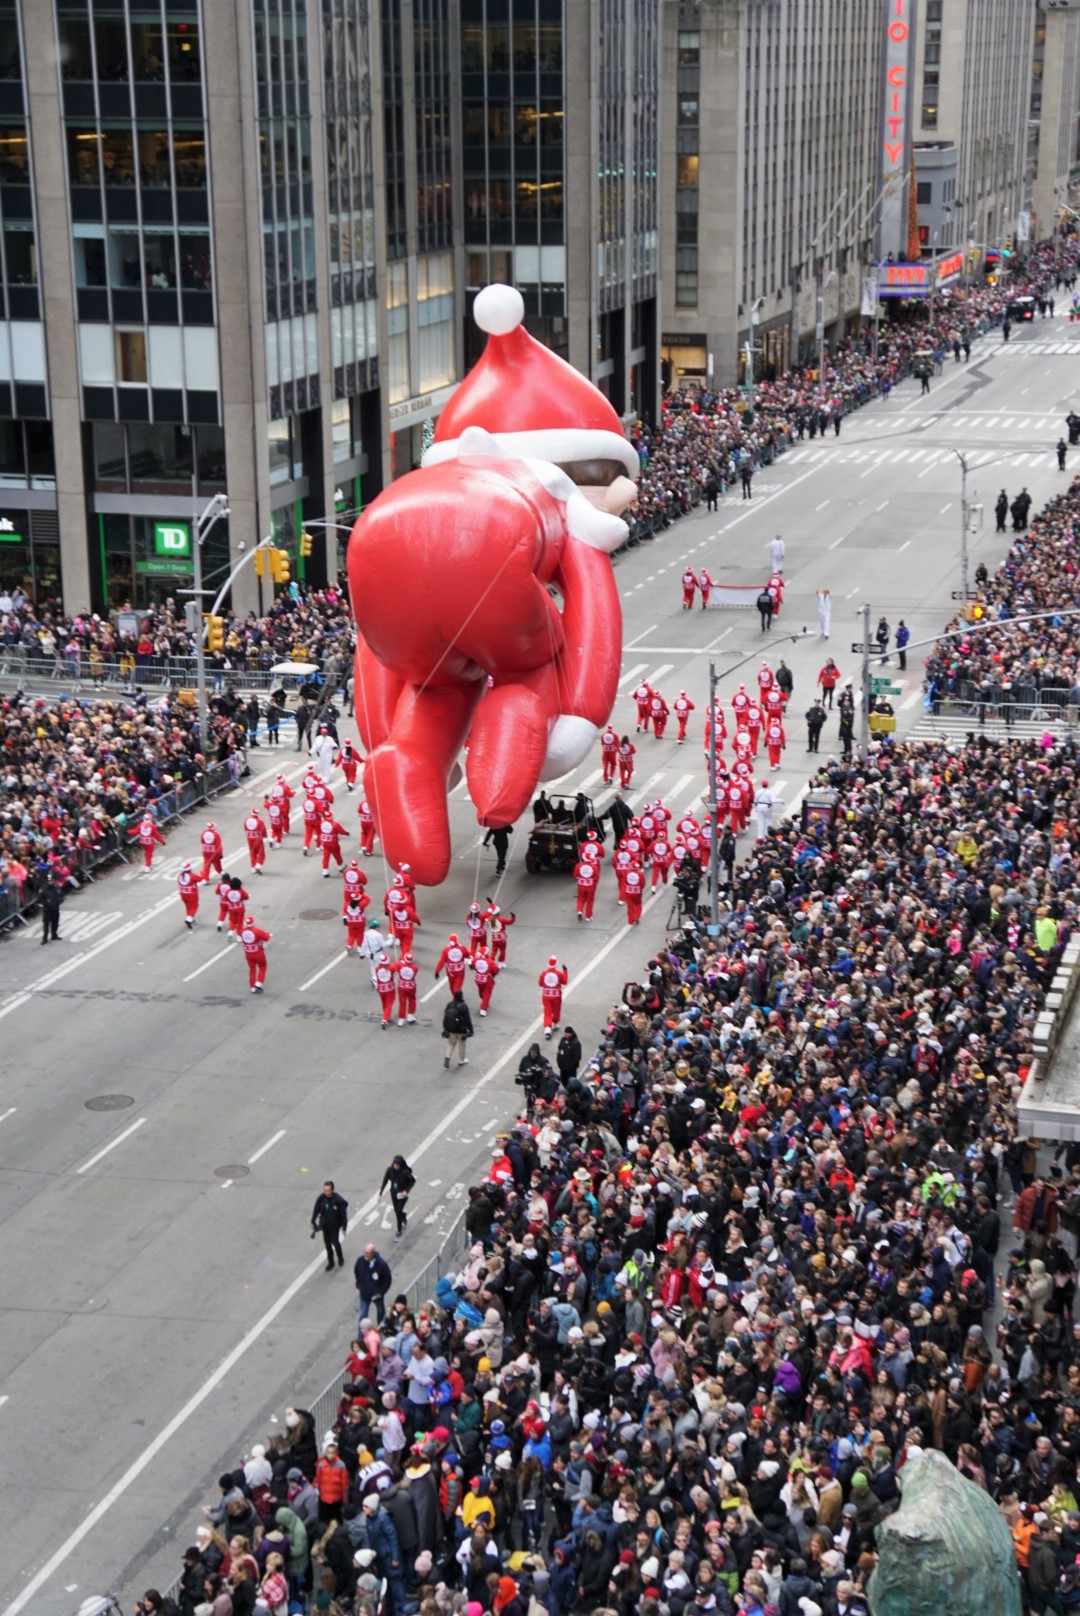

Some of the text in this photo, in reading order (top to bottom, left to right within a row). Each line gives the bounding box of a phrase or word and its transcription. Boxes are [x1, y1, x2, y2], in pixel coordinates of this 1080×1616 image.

[884, 66, 905, 163] CITY
[157, 527, 187, 549] TD
[148, 562, 165, 571] Open
